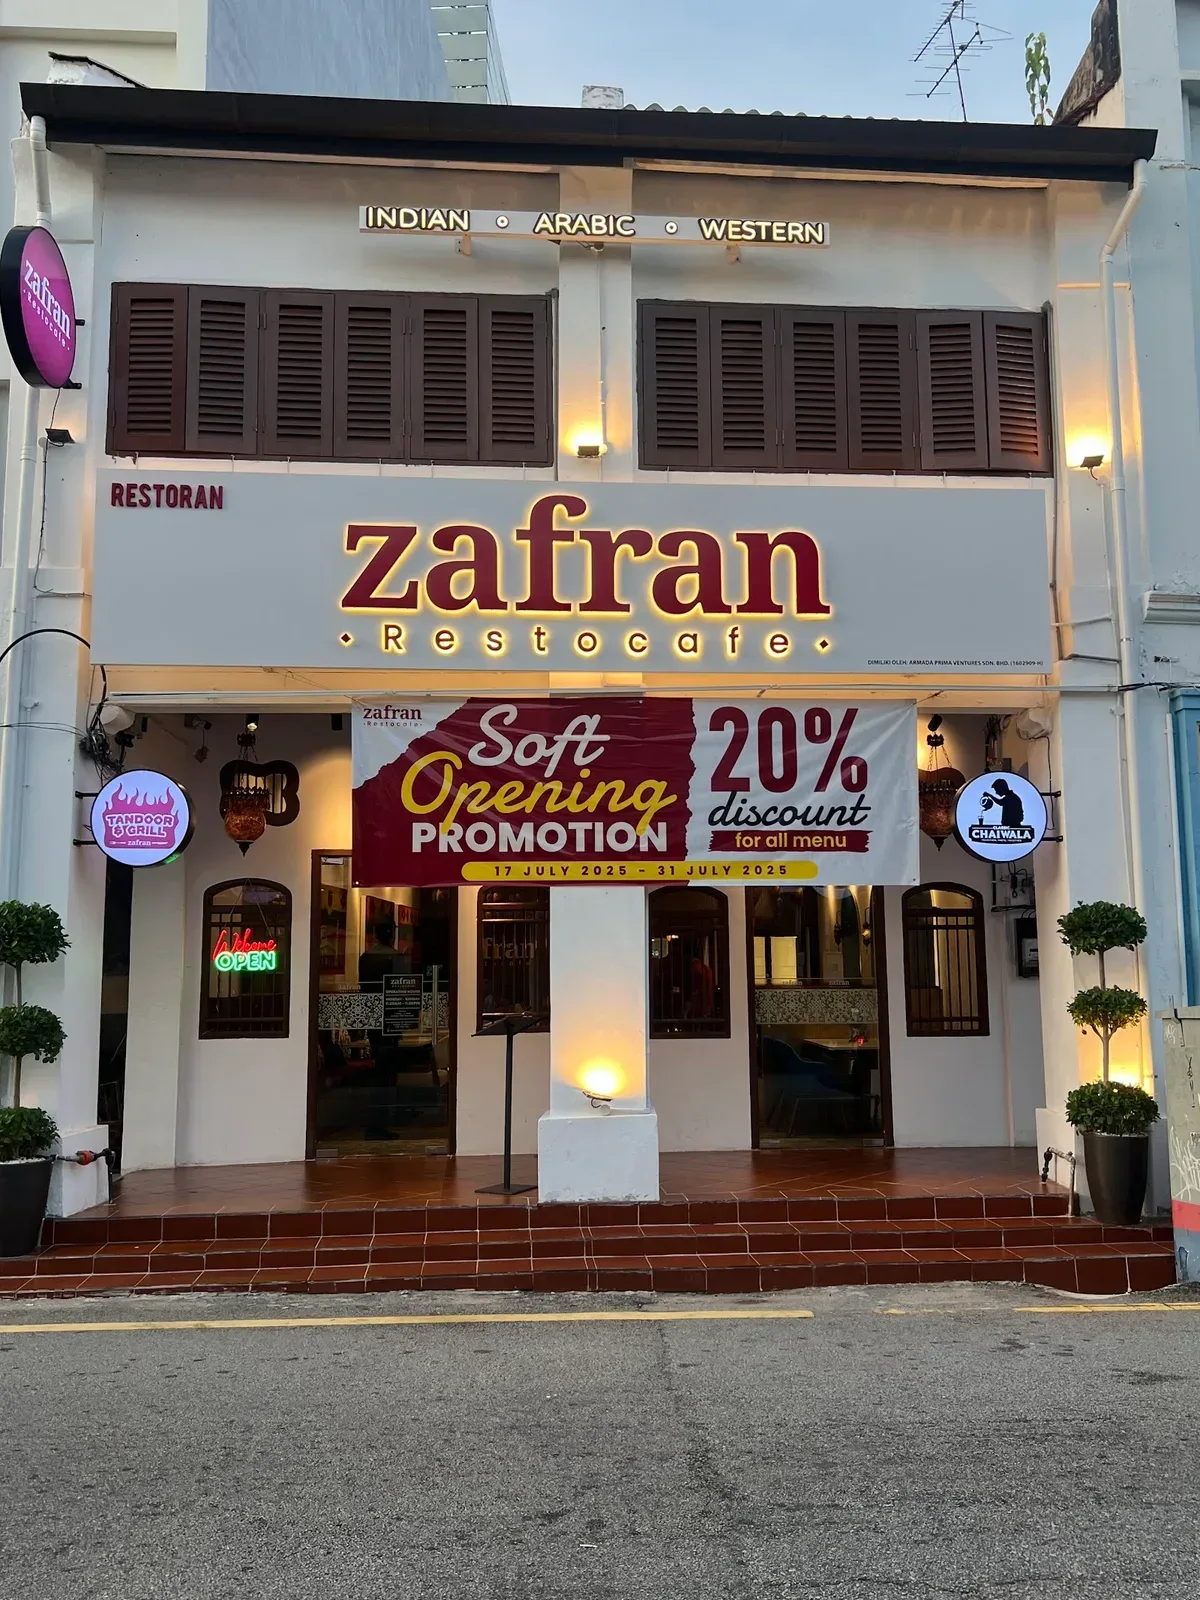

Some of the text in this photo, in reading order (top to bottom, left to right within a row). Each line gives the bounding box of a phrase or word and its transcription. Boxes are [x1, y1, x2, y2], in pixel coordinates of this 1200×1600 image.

[366, 206, 825, 244] INDIAN ARABIC WESTERN
[23, 260, 71, 339] zafran
[110, 482, 223, 509] RESTORAN
[341, 494, 831, 615] zafran
[383, 624, 790, 655] Restocafe
[363, 704, 423, 720] zafran
[468, 703, 611, 778] Soft
[708, 706, 868, 793] 20%
[401, 751, 678, 837] Opening
[708, 790, 872, 827] discount
[106, 814, 174, 827] TANDOOR
[113, 825, 166, 837] & GRILL
[971, 829, 1031, 839] CHAIWALA
[412, 821, 668, 853] PROMOTION
[735, 832, 847, 849] for all menu
[494, 865, 513, 876] 17
[523, 865, 570, 877] JULY
[581, 865, 628, 876] 2025
[657, 864, 676, 876] 31
[686, 864, 732, 877] JULY
[742, 864, 788, 876] 2025
[212, 928, 277, 961] Welcome
[215, 951, 277, 971] OPEN
[390, 977, 416, 985] zafran
